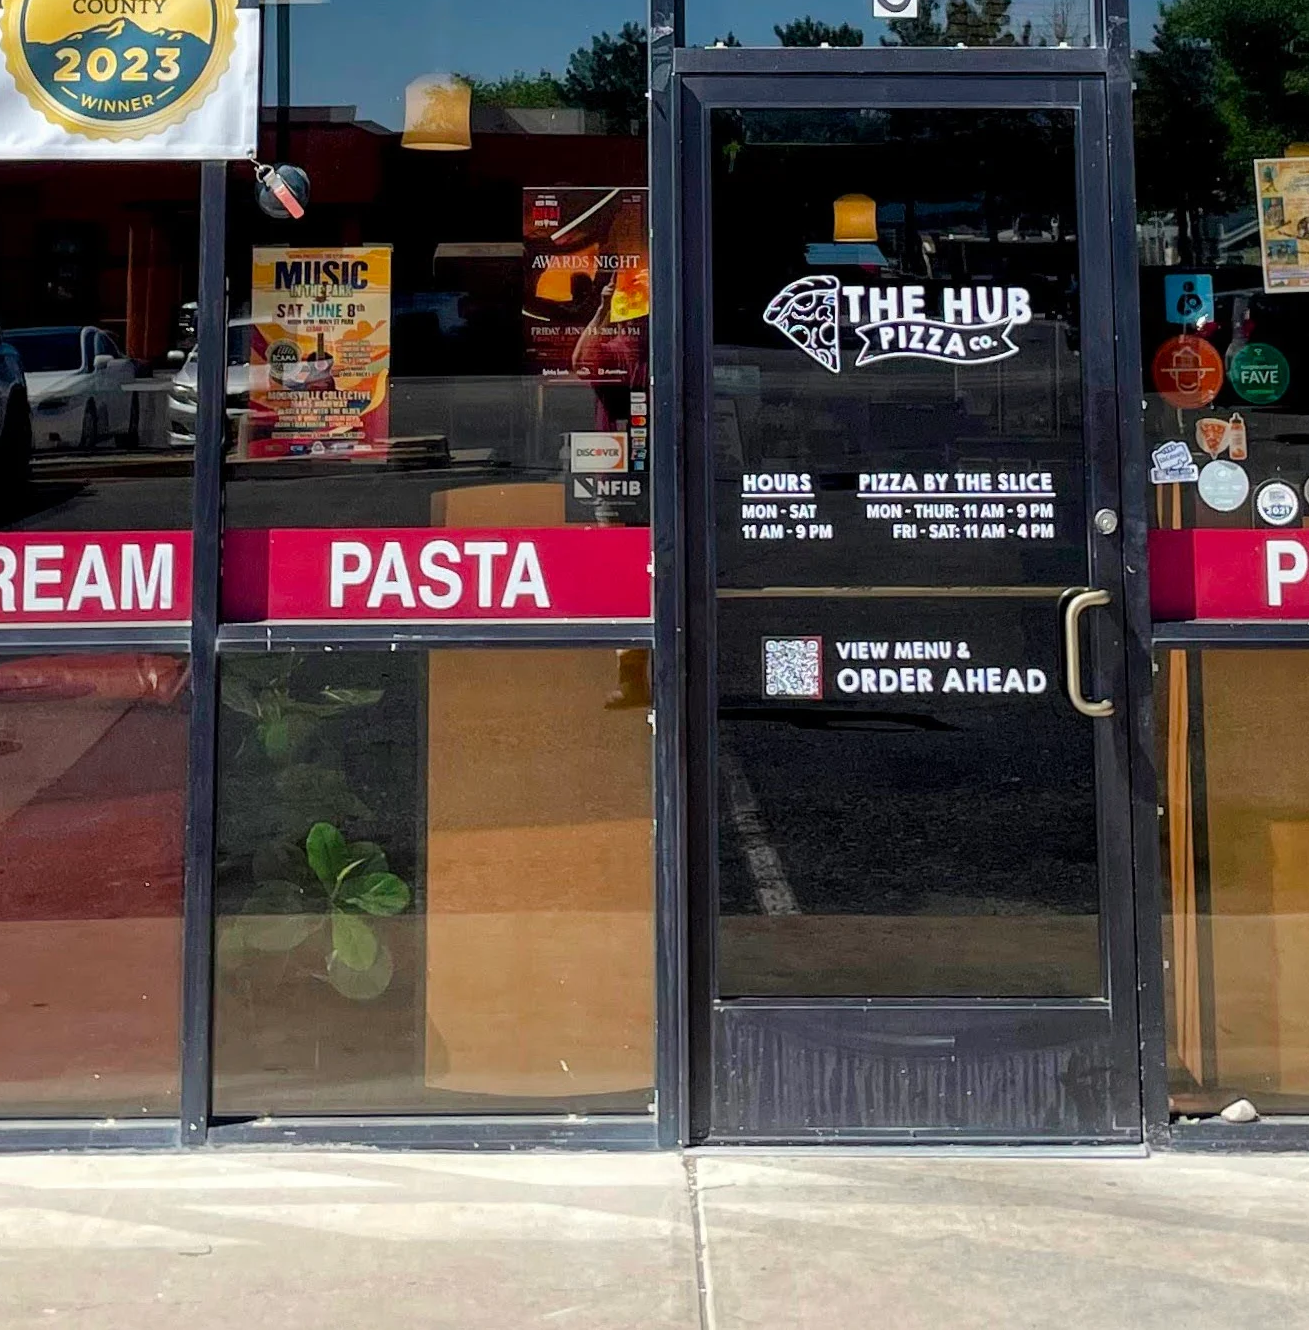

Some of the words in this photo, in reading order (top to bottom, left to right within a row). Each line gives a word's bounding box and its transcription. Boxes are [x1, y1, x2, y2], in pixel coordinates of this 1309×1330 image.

[53, 47, 181, 83] 2023
[80, 93, 155, 113] WINNER
[532, 255, 589, 269] AWARDS
[593, 255, 641, 269] NIGHT
[274, 260, 369, 289] MUSIC
[325, 284, 354, 298] PARK
[277, 303, 304, 318] SAT
[306, 303, 342, 318] JUNE
[347, 302, 366, 318] 8th
[842, 286, 926, 323] THE
[944, 287, 1032, 324] HUB
[531, 327, 560, 335] FRIDAY
[879, 326, 966, 357] PIZZA
[970, 336, 998, 350] CO.
[1241, 370, 1279, 384] FAVE
[576, 448, 619, 457] DISCOVER
[597, 481, 641, 496] NFIB
[742, 474, 812, 492] HOURS
[859, 473, 918, 491] PIZZA
[923, 473, 949, 491] BY
[954, 473, 992, 491] THE
[997, 473, 1053, 491] SLICE
[742, 504, 778, 519] MON
[790, 504, 817, 519] SAT
[866, 504, 902, 519] MON
[914, 503, 960, 519] THUR:
[962, 503, 977, 518] 11
[980, 503, 1004, 518] AM
[1017, 503, 1027, 518] 9
[1030, 503, 1054, 518] PM
[1266, 507, 1290, 515] 2021
[742, 524, 757, 539] 11
[759, 524, 784, 539] AM
[795, 524, 806, 539] 9
[809, 524, 833, 539] PM
[892, 524, 917, 539] FRI
[929, 524, 960, 539] SAT:
[963, 523, 978, 539] 11
[981, 523, 1005, 539] AM
[1017, 523, 1027, 538] 4
[1031, 523, 1055, 539] PM
[330, 539, 551, 609] PASTA
[836, 641, 889, 659] VIEW
[894, 641, 951, 659] MENU
[956, 641, 971, 659] &
[837, 668, 934, 693] ORDER
[942, 668, 1047, 693] AHEAD
